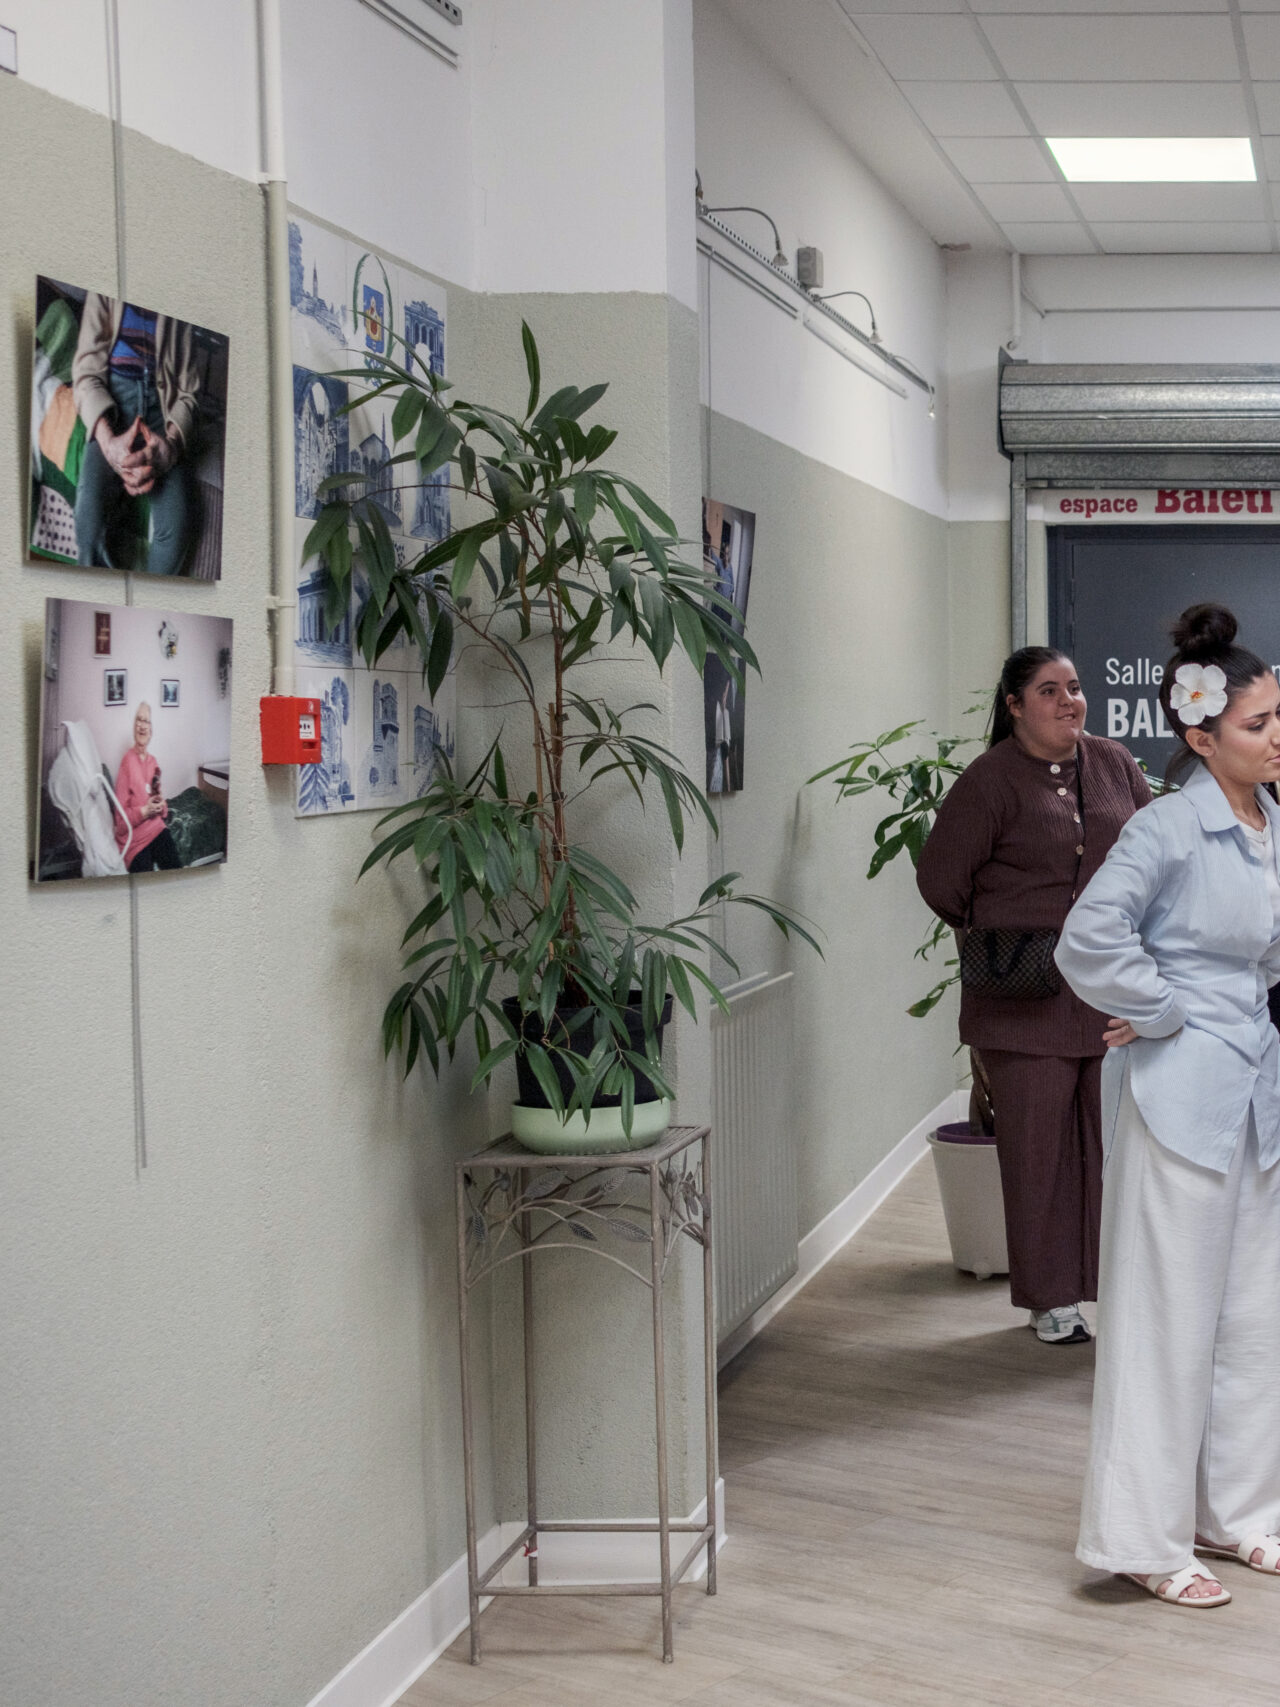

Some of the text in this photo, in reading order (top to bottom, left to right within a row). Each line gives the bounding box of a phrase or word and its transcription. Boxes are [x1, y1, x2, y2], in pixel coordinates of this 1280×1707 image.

[1059, 497, 1139, 519] espace
[1105, 657, 1163, 685] Salle
[1107, 698, 1175, 738] BAL
